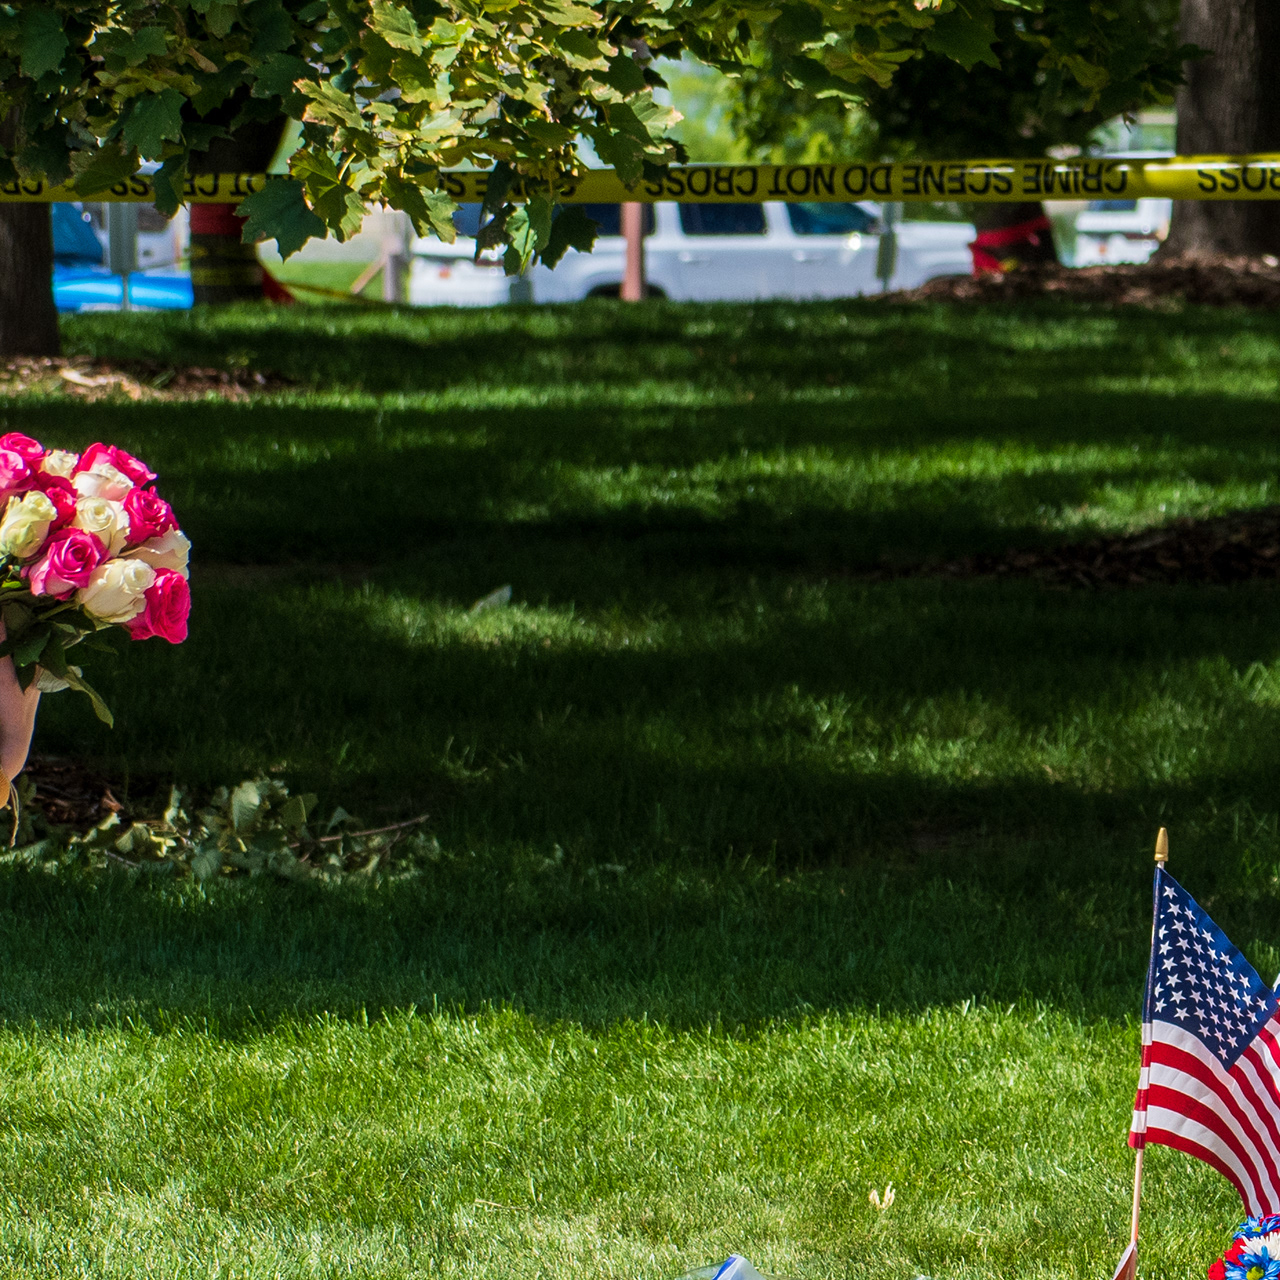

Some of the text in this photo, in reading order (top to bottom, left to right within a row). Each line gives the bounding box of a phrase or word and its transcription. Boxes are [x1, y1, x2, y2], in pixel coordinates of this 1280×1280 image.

[767, 167, 837, 197] NOT
[843, 166, 893, 196] DO
[902, 165, 1013, 196] SCENE
[1023, 164, 1129, 195] CRIME
